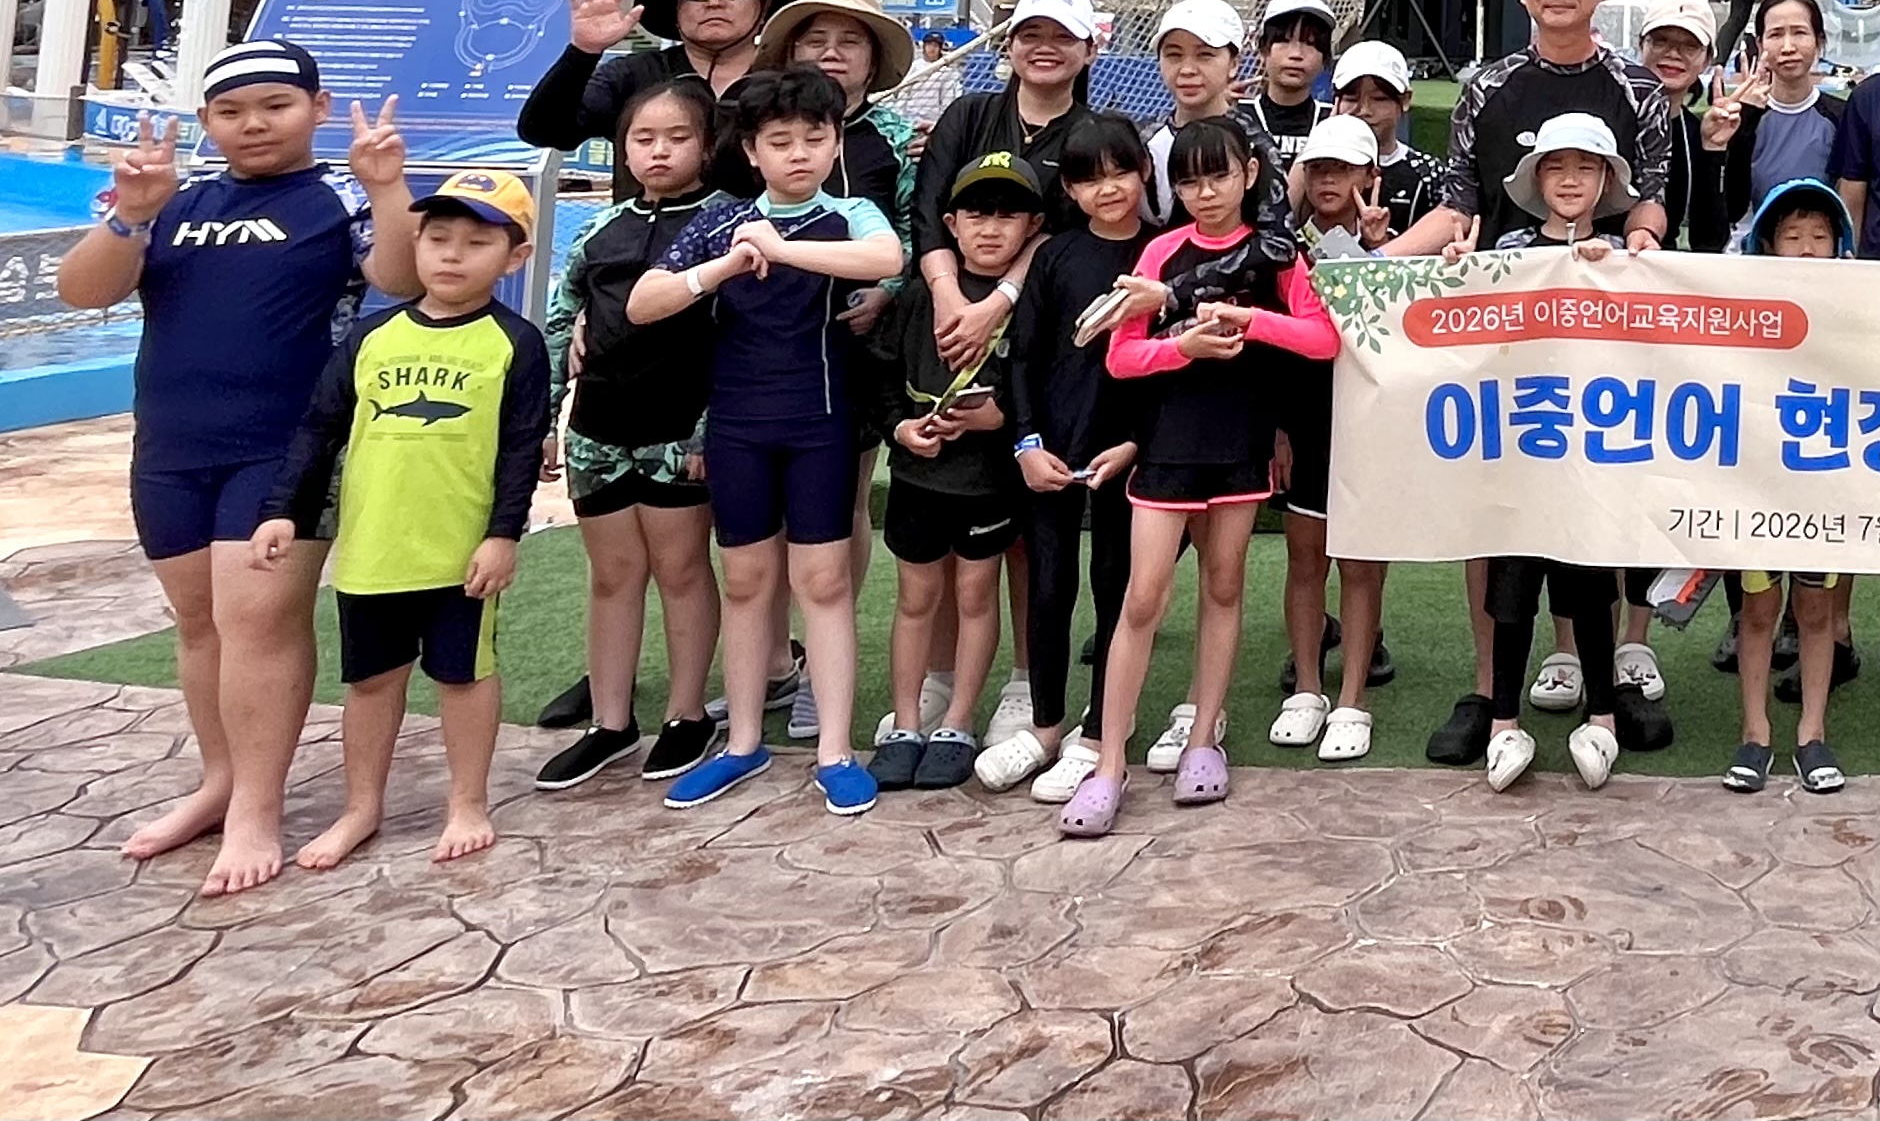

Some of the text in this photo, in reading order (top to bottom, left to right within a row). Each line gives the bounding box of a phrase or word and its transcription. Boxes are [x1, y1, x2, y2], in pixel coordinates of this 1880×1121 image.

[1431, 298, 1784, 339] 2026년 이중언어교육지원사업
[378, 366, 471, 391] SHARK
[1426, 375, 1741, 467] 이중언어
[1668, 509, 1723, 539] 기간
[1750, 511, 1846, 543] 2026년
